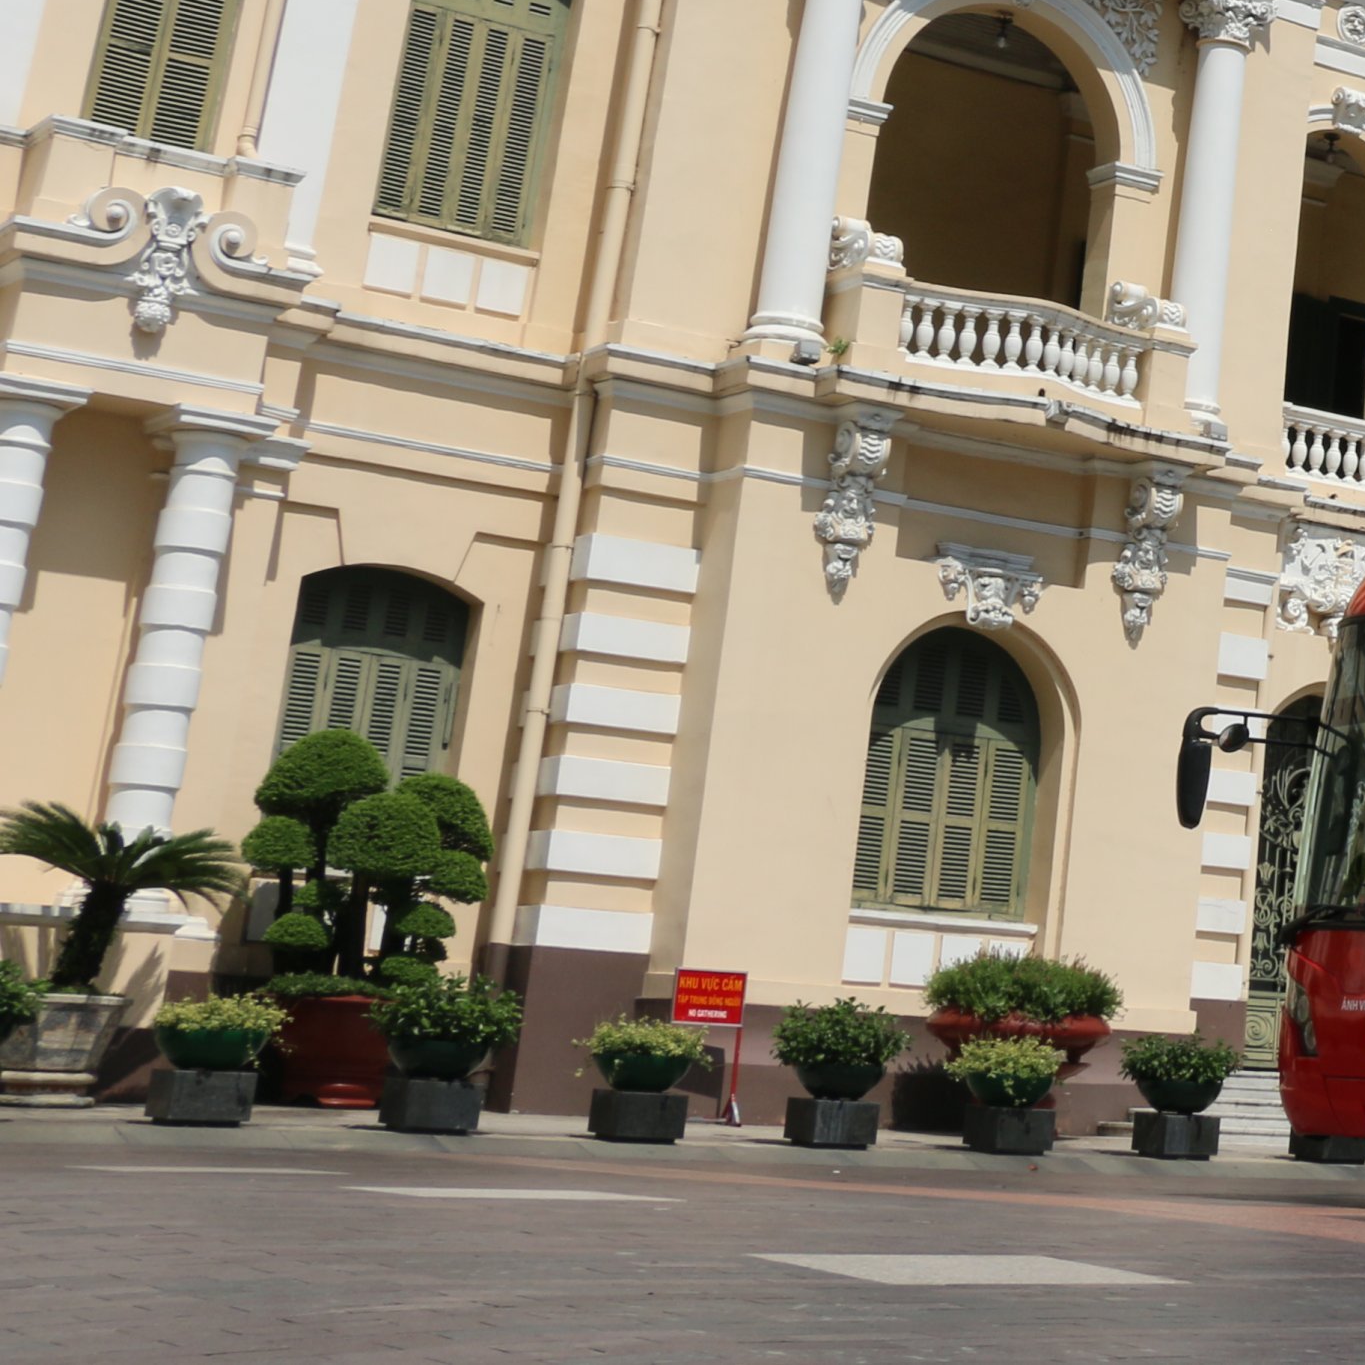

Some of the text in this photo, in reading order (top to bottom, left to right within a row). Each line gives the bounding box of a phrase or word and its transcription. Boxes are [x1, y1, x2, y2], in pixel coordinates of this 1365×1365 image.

[679, 976, 700, 989] KHU
[722, 974, 743, 991] CẤM
[687, 1008, 728, 1019] NO GATHERING
